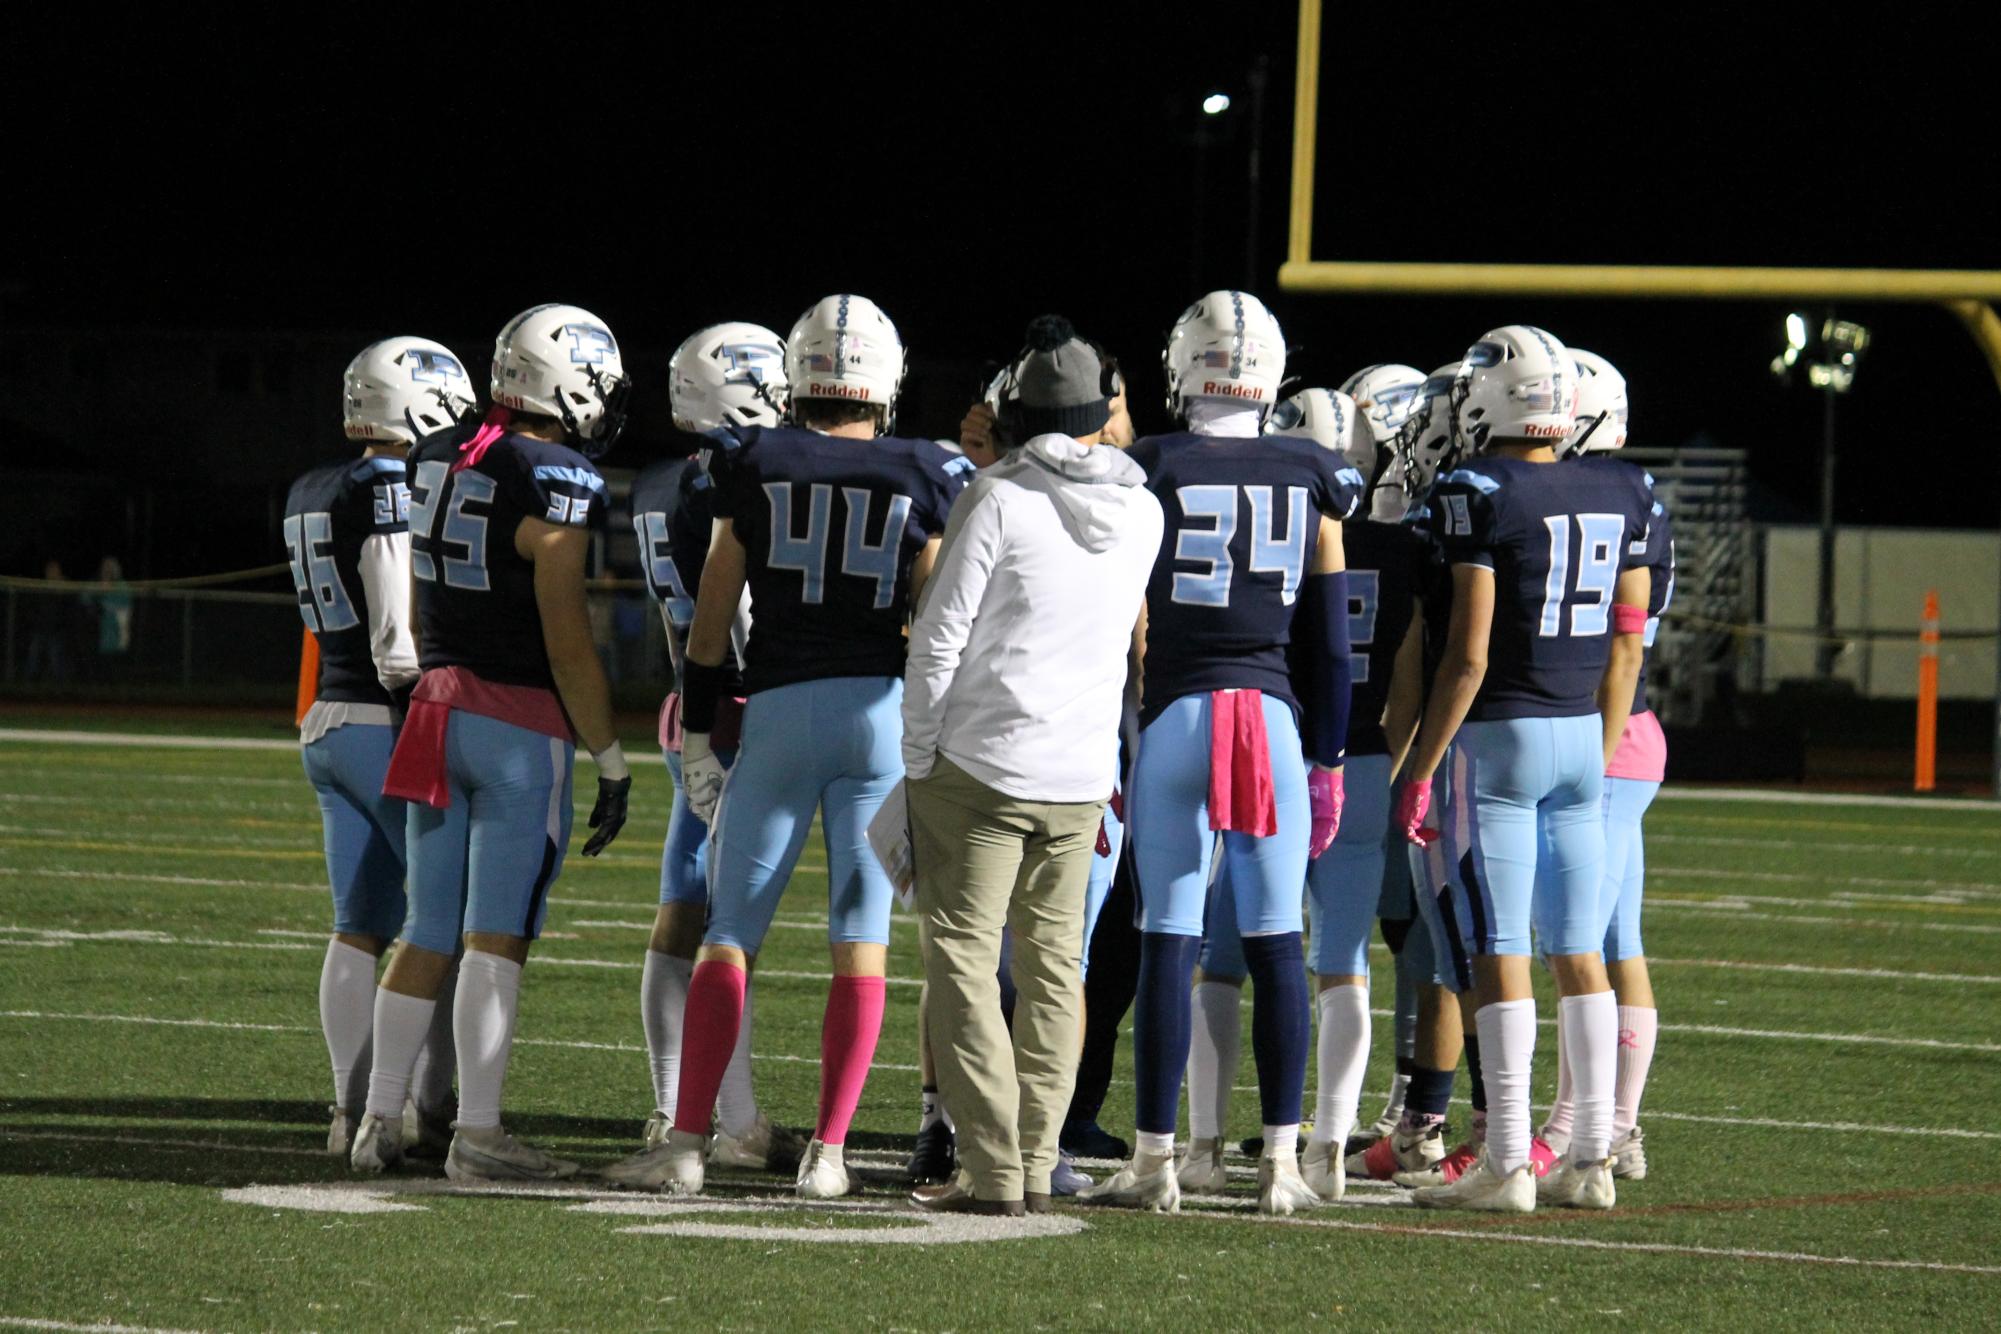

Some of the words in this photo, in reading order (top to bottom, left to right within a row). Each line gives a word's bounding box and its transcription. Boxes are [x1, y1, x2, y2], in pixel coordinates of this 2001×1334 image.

[809, 383, 870, 400] Riddell
[849, 355, 861, 364] 44
[1203, 381, 1264, 400] Riddell
[409, 461, 497, 591] 25
[761, 481, 913, 609] 44
[1170, 485, 1309, 607] 34
[1439, 494, 1472, 536] 19
[1539, 513, 1626, 637] 19
